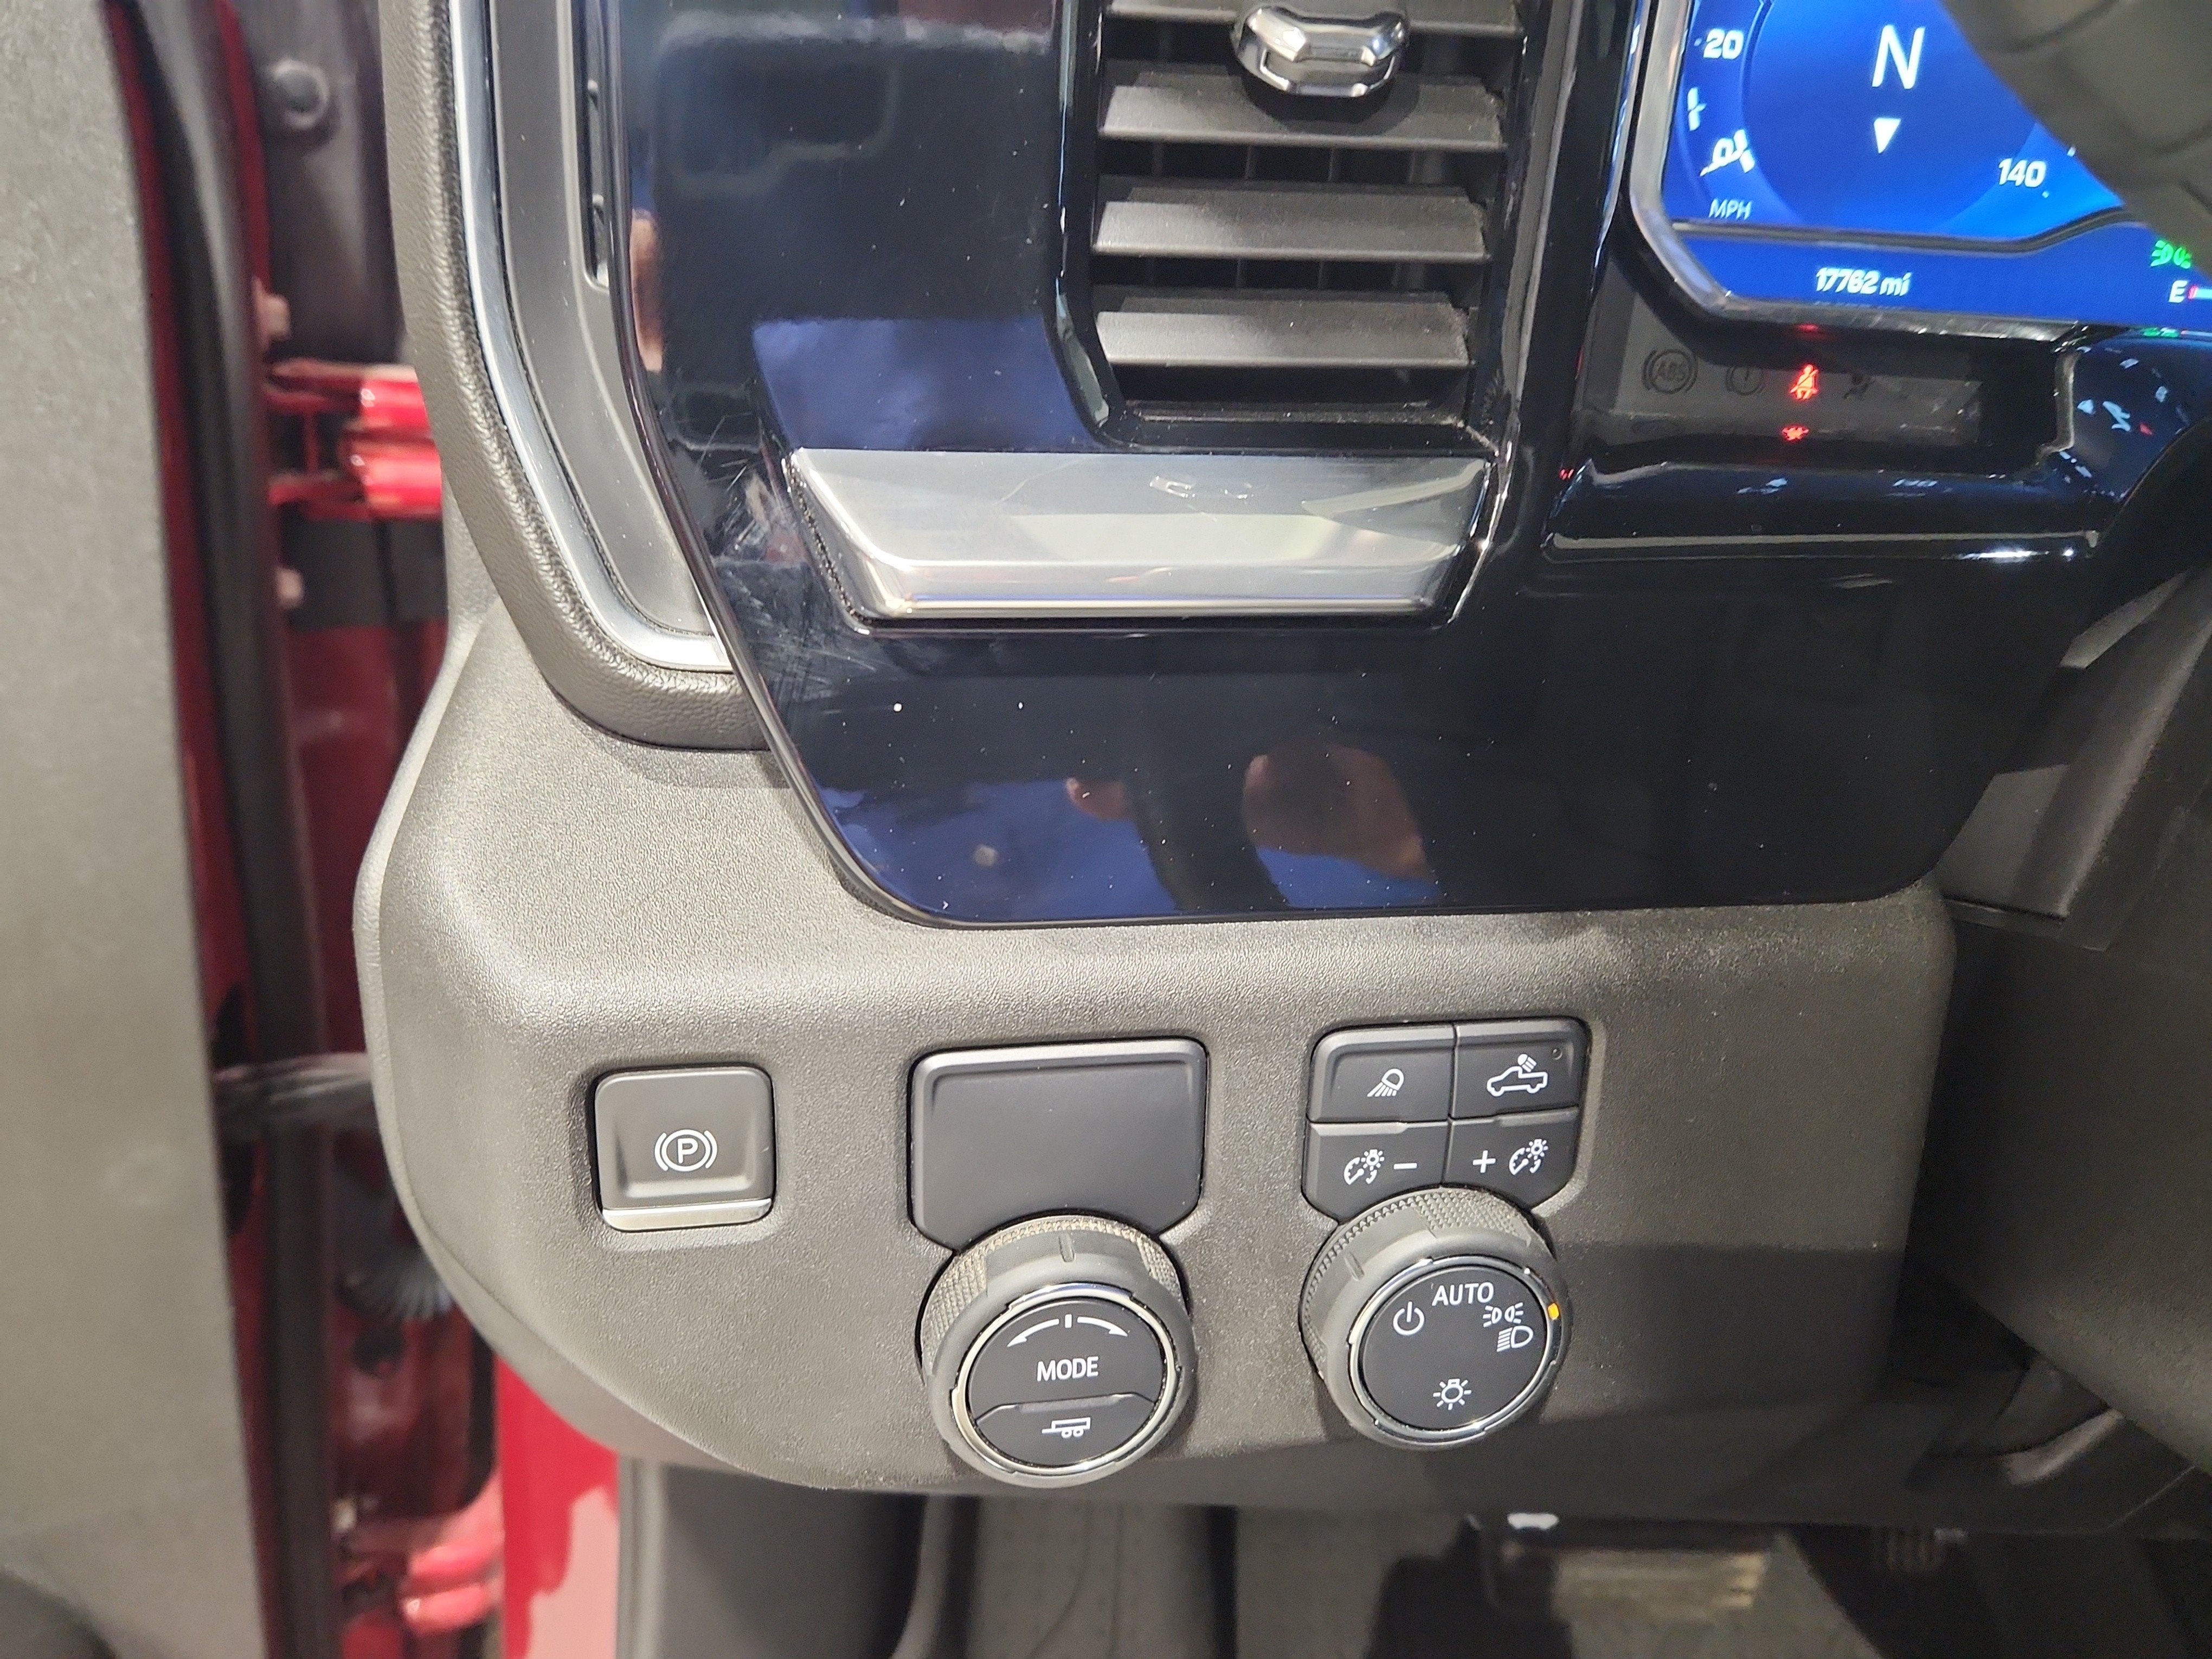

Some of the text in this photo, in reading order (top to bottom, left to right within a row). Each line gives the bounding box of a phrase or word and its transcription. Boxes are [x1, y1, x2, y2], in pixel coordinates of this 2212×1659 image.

[1703, 28, 1744, 60] 20
[1872, 24, 1925, 89] N
[1998, 158, 2047, 188] 140
[1708, 198, 1752, 220] MPH
[1879, 272, 1912, 297] mi
[2169, 280, 2188, 304] E
[677, 1137, 698, 1164] P
[1431, 1282, 1494, 1307] AUTO
[1037, 1356, 1099, 1382] MODE
